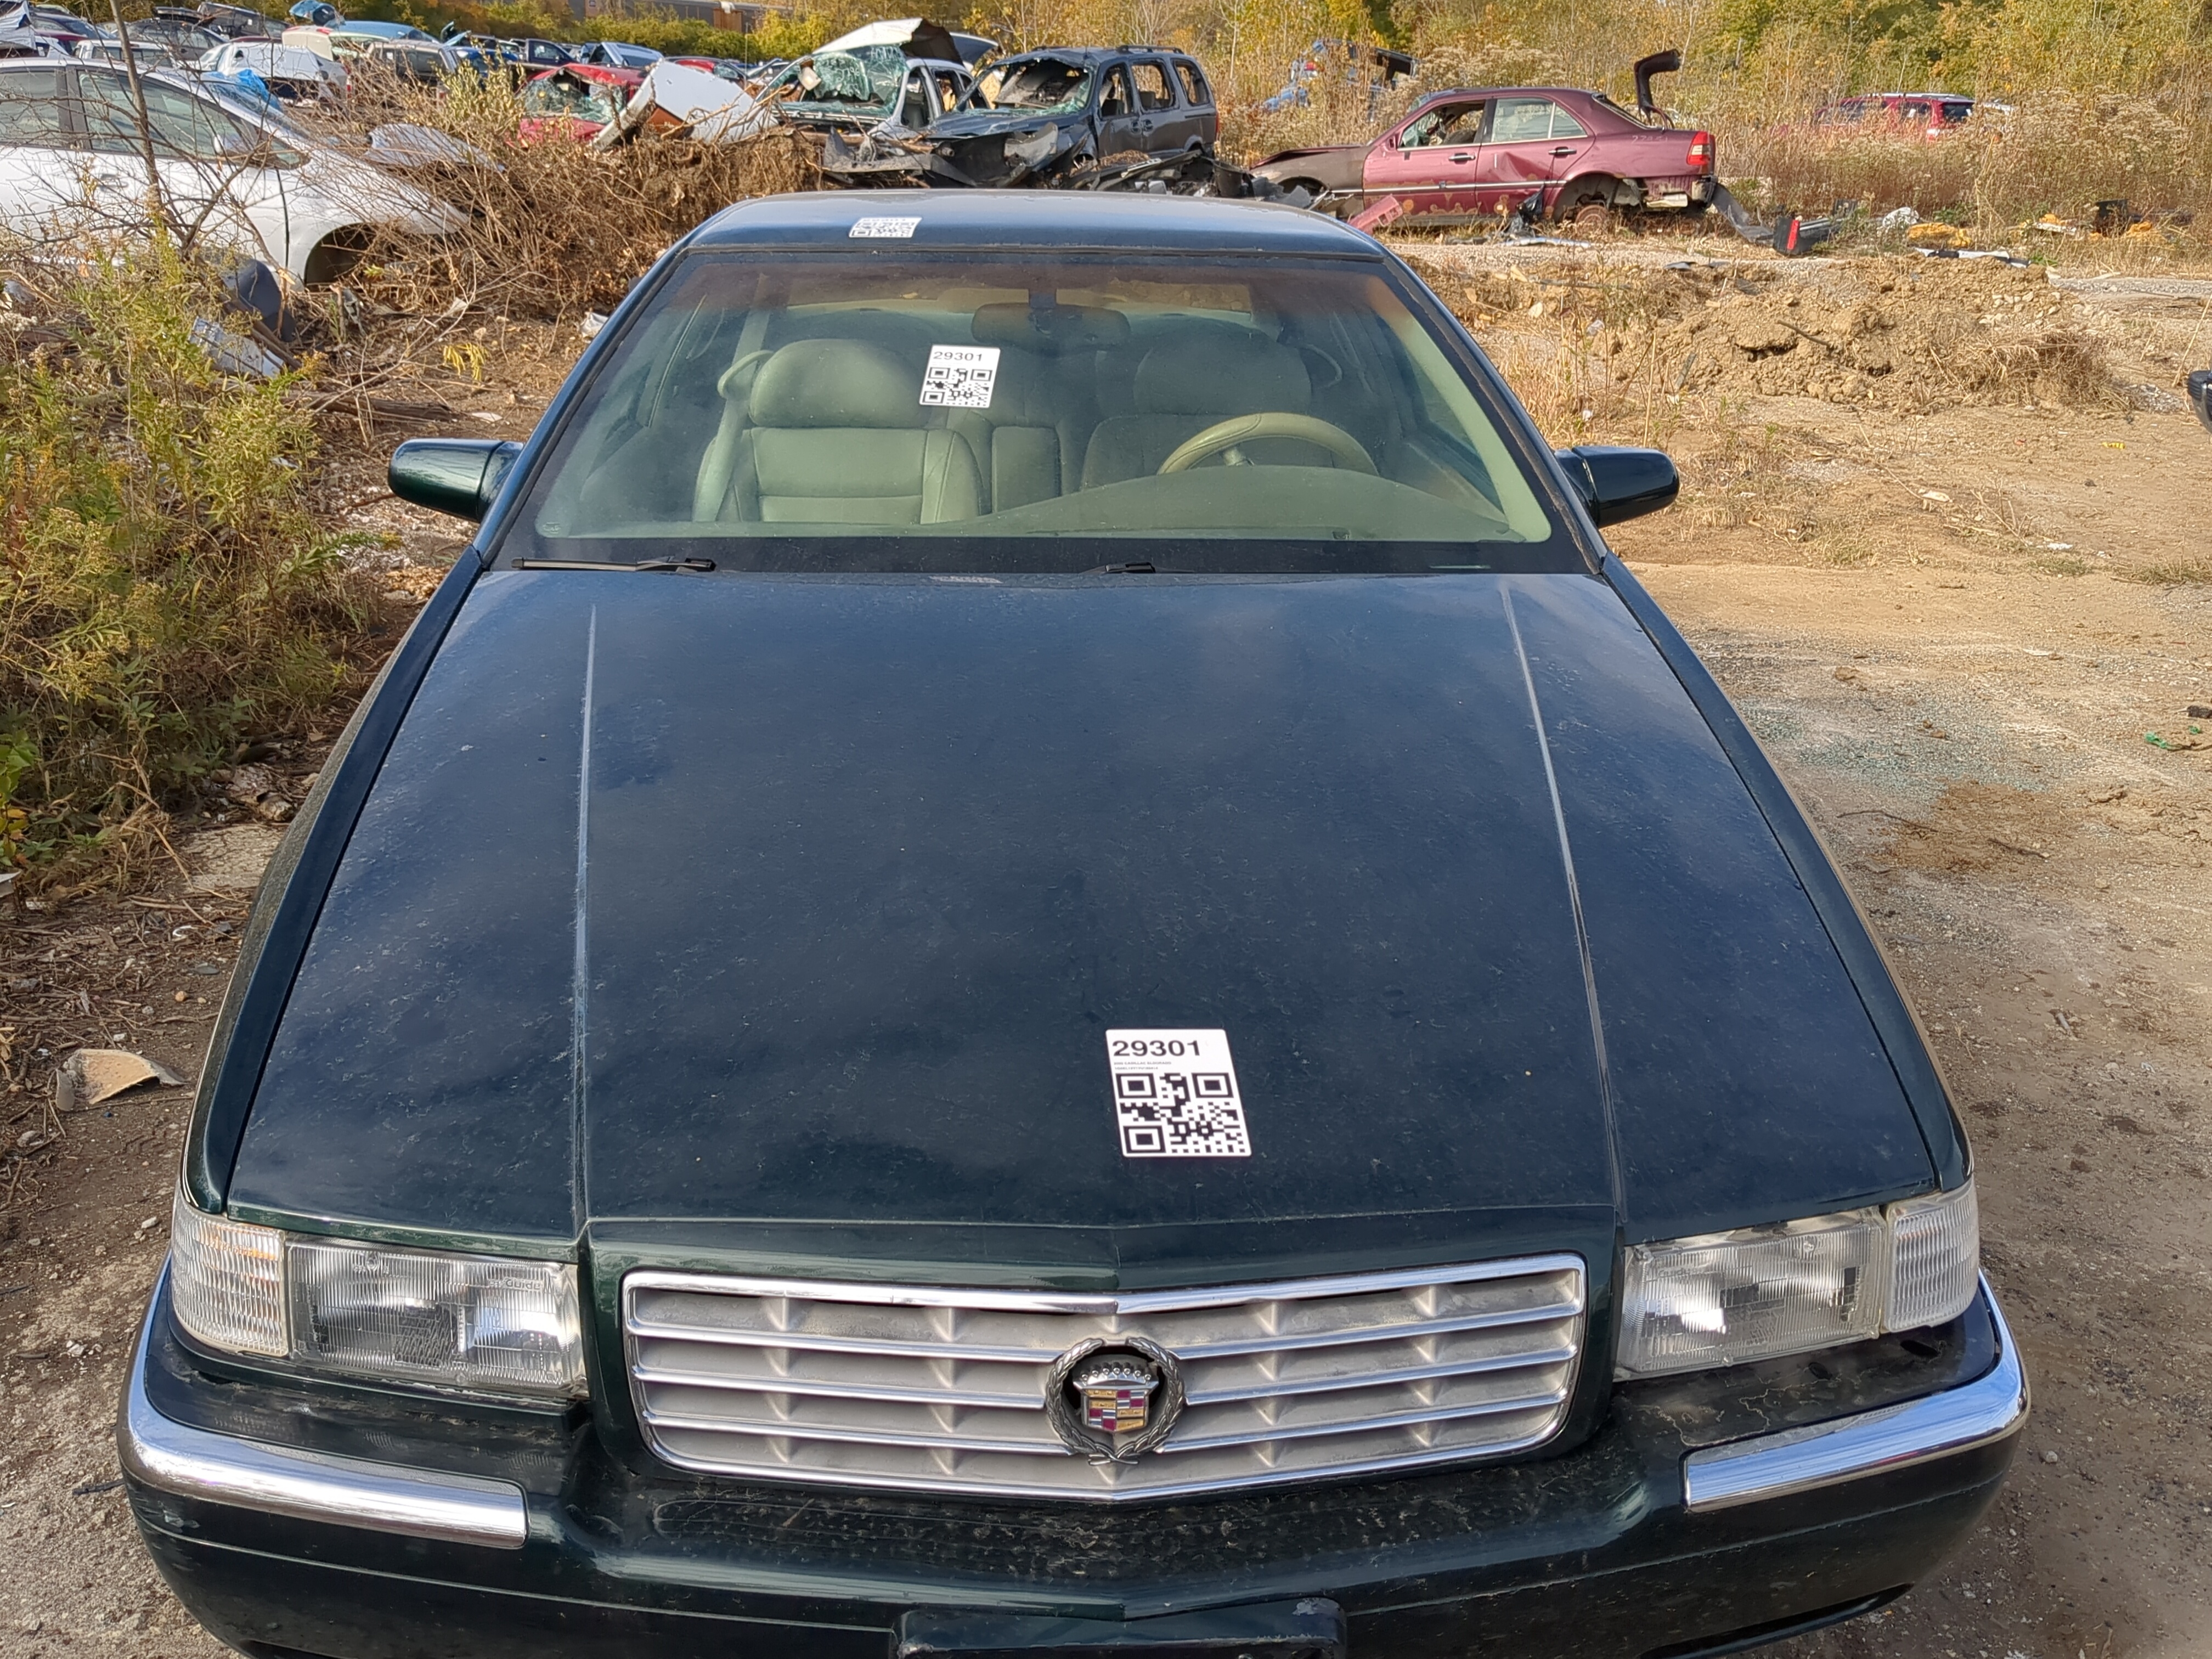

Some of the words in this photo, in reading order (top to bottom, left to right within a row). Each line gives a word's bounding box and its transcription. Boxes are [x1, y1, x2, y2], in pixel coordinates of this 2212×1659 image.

[933, 351, 983, 361] 29301
[1112, 1040, 1200, 1057] 29301
[505, 1278, 541, 1290] Guide
